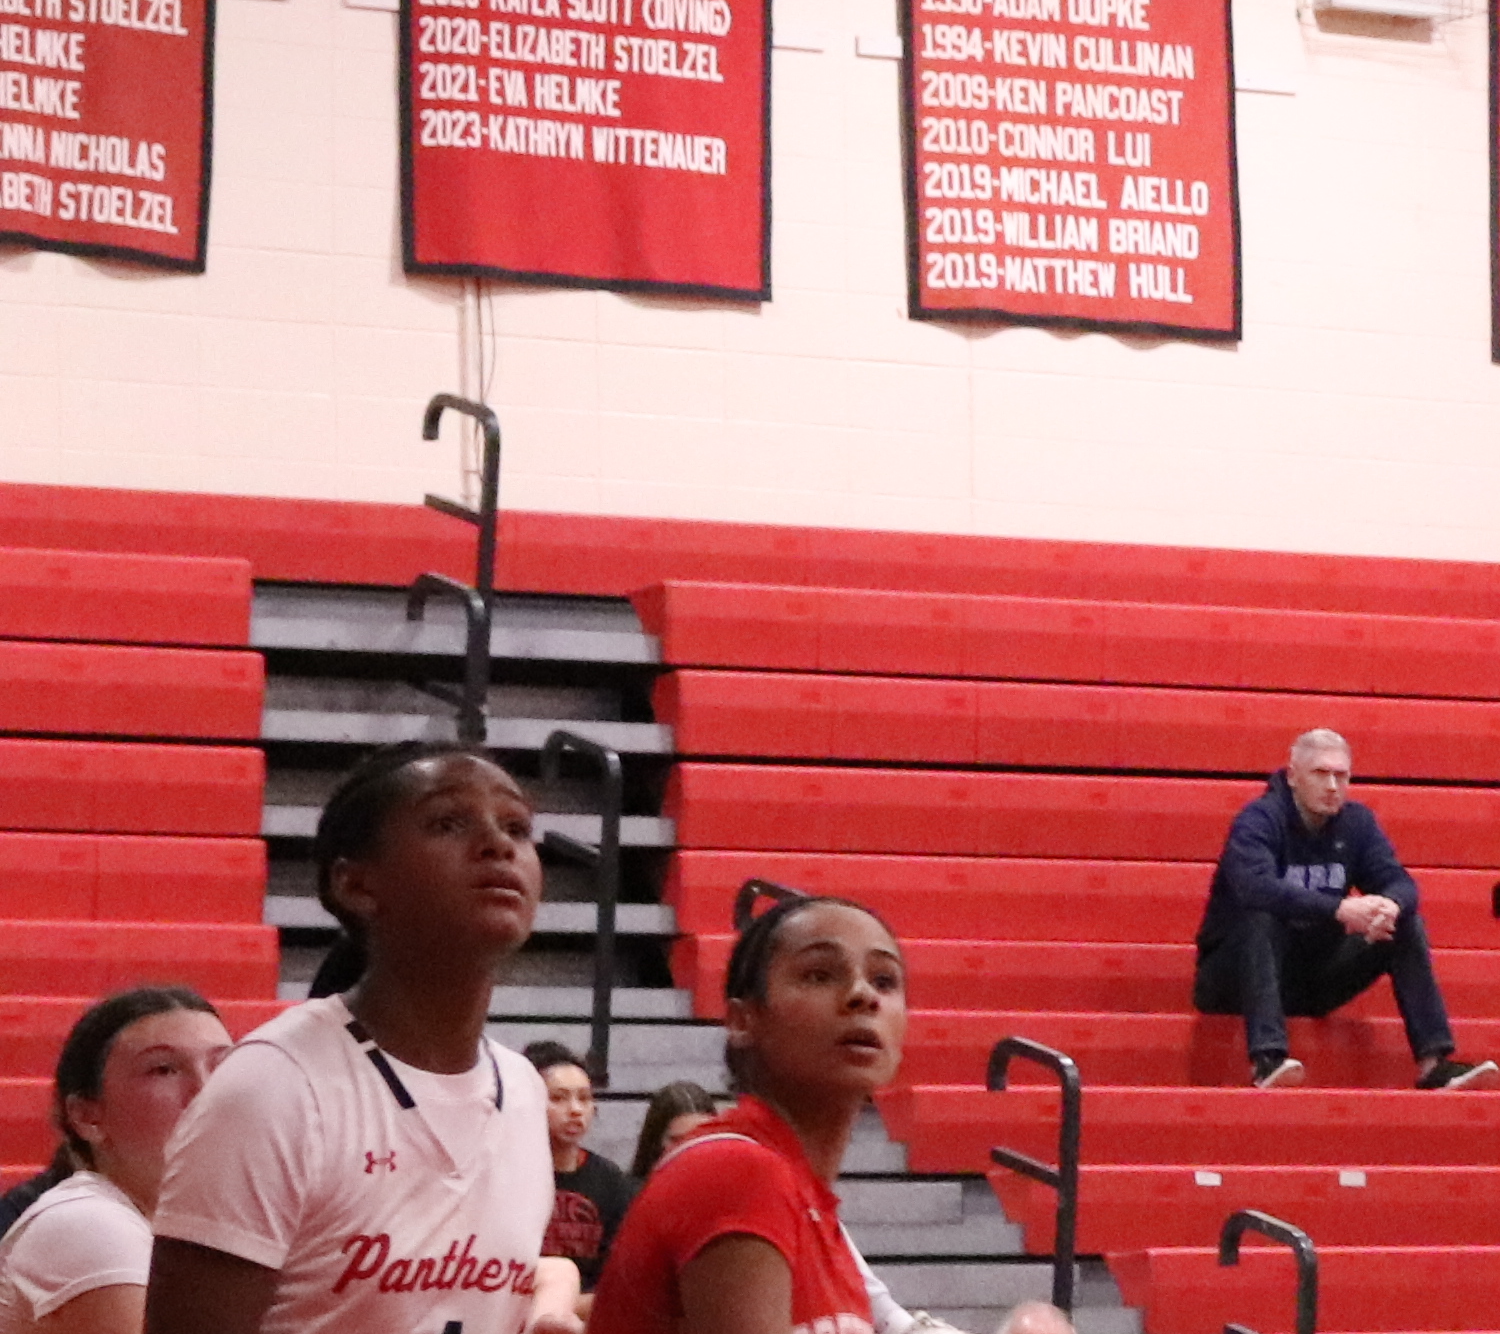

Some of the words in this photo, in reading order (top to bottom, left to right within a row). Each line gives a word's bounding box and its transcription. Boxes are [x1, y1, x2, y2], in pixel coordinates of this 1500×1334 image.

[420, 17, 605, 69] 2020-ELIZABETH
[615, 36, 723, 82] STOELZEL
[922, 25, 1066, 68] 1994-KEVIN
[1074, 37, 1194, 79] CULLINAN
[420, 64, 527, 107] 2021-EVA
[535, 74, 621, 117] HELMKE
[922, 71, 1046, 114] 2009-KEN
[1056, 82, 1183, 124] PANCOAST
[50, 132, 165, 181] NICHOLAS
[421, 111, 583, 159] 2023-KATHRYN
[593, 127, 726, 174] WITTENAUER
[923, 118, 1094, 162] 2010-CONNOR
[1108, 131, 1150, 167] LUI
[59, 184, 178, 234] STOELZEL
[924, 164, 1107, 208] 2019-MICHAEL
[1121, 177, 1208, 215] AIELLO
[926, 209, 1098, 251] 2019-WILLIAM
[1109, 219, 1198, 259] BRIAND
[927, 254, 1115, 297] 2019-MATTHEW
[1129, 264, 1192, 303] HULL
